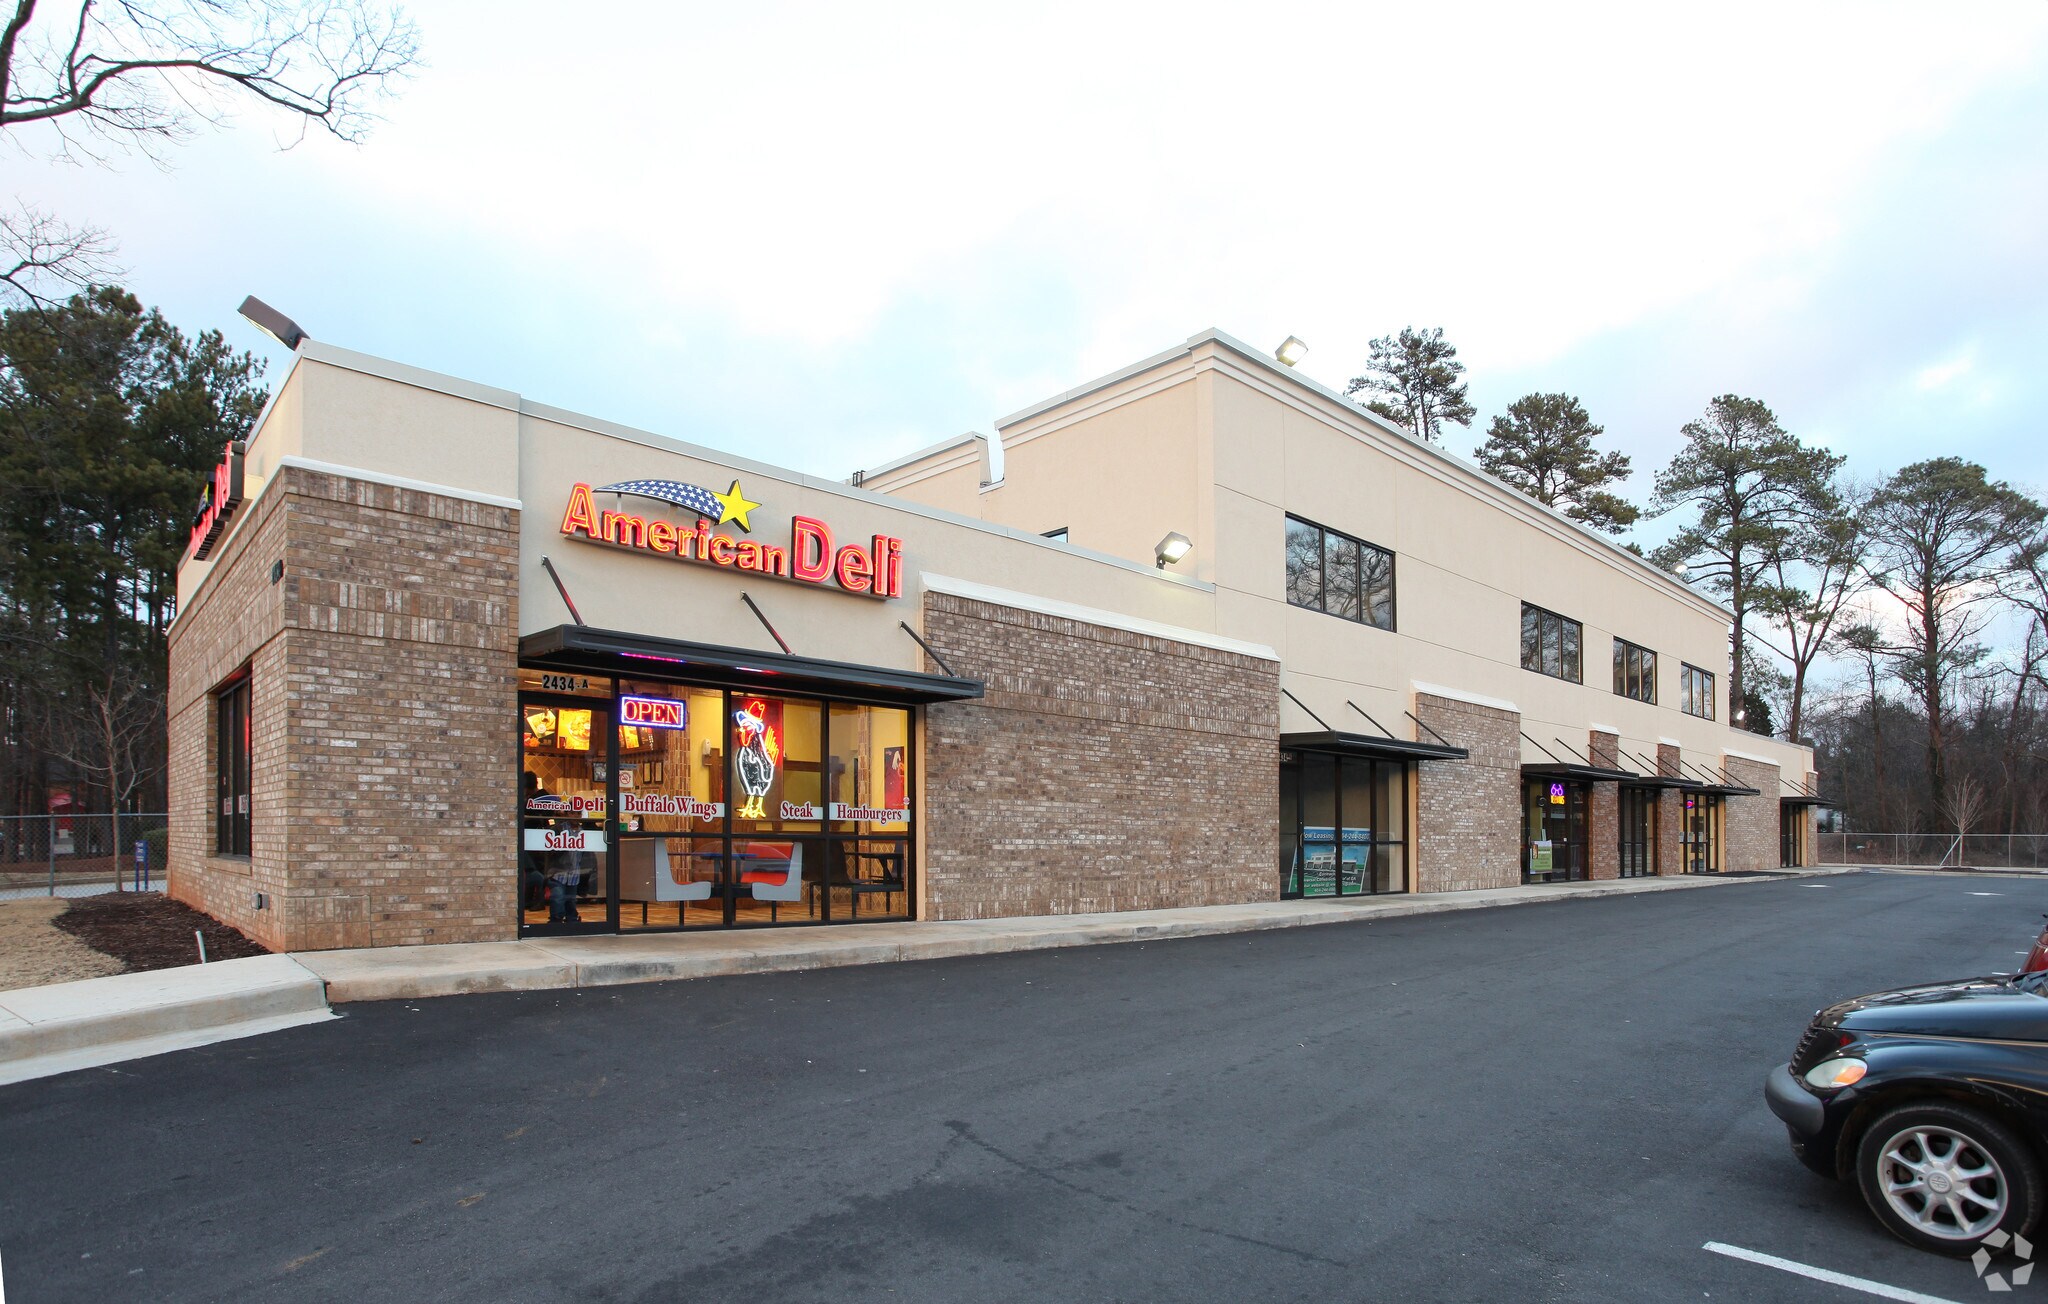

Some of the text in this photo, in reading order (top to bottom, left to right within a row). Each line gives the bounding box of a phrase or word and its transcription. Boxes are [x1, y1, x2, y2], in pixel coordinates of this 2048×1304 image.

[559, 482, 903, 598] American Deli
[624, 701, 681, 724] OPEN
[526, 796, 605, 812] American Deli
[625, 794, 717, 820] Buffalo Wings
[781, 802, 814, 818] Steak
[837, 804, 902, 824] Hamburgers
[544, 832, 586, 850] Salad
